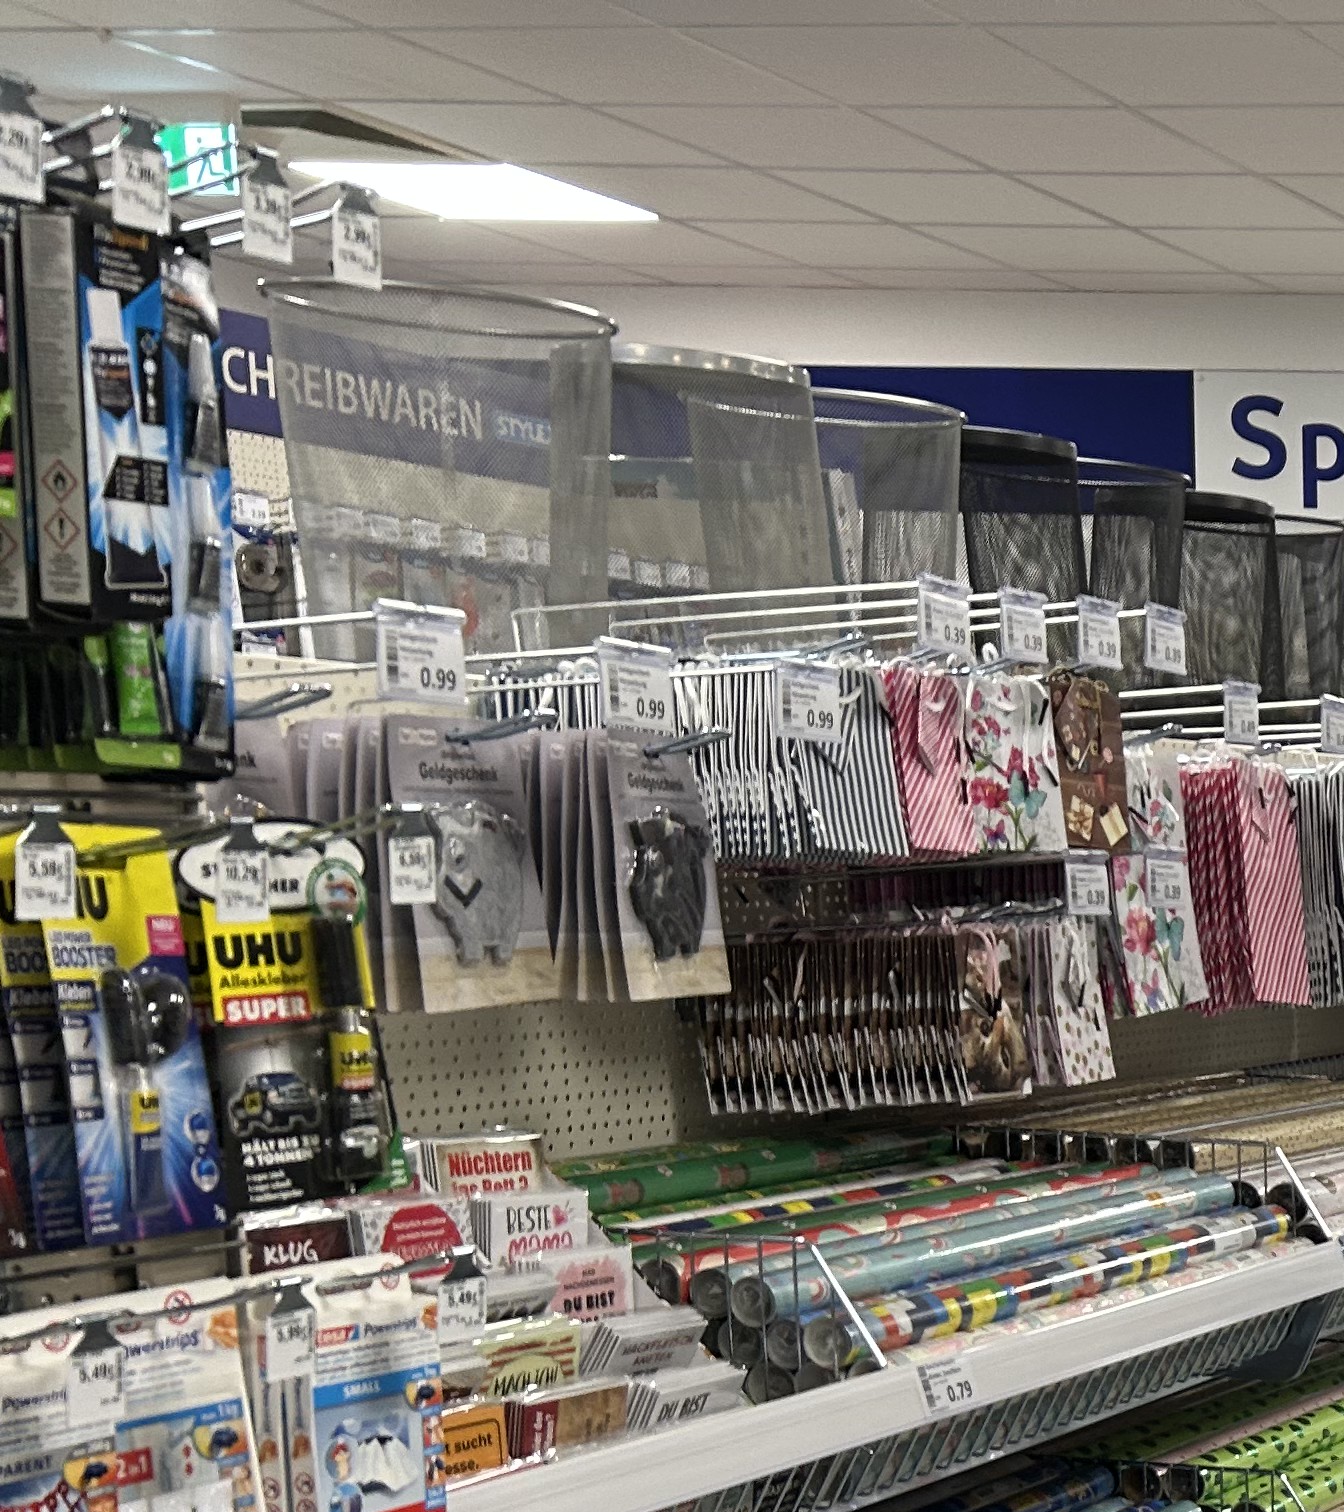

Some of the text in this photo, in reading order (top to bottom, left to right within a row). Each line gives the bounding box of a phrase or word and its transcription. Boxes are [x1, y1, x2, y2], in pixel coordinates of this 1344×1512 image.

[221, 347, 483, 442] CHREIBWAREN
[944, 624, 966, 645] 0.39
[1024, 633, 1043, 651] 0.39
[1098, 639, 1117, 658] 0.39
[1164, 645, 1182, 663] 0.39
[420, 666, 456, 691] 0.99
[636, 697, 665, 720] 0.99
[807, 709, 834, 729] 0.99
[419, 760, 498, 784] Geldgeschenk
[627, 771, 686, 794] Geldgeschenk
[1087, 889, 1105, 905] 0.39
[1164, 884, 1181, 900] 0.39
[212, 930, 304, 970] UHU
[225, 995, 309, 1023] SUPER
[448, 1149, 533, 1177] Nüchtern
[506, 1204, 552, 1236] BESTE
[263, 1239, 319, 1267] KLUG
[563, 1290, 615, 1313] DU BIST
[947, 1381, 973, 1402] 0.79
[656, 1392, 711, 1423] DU BIST
[454, 1431, 493, 1454] sucht
